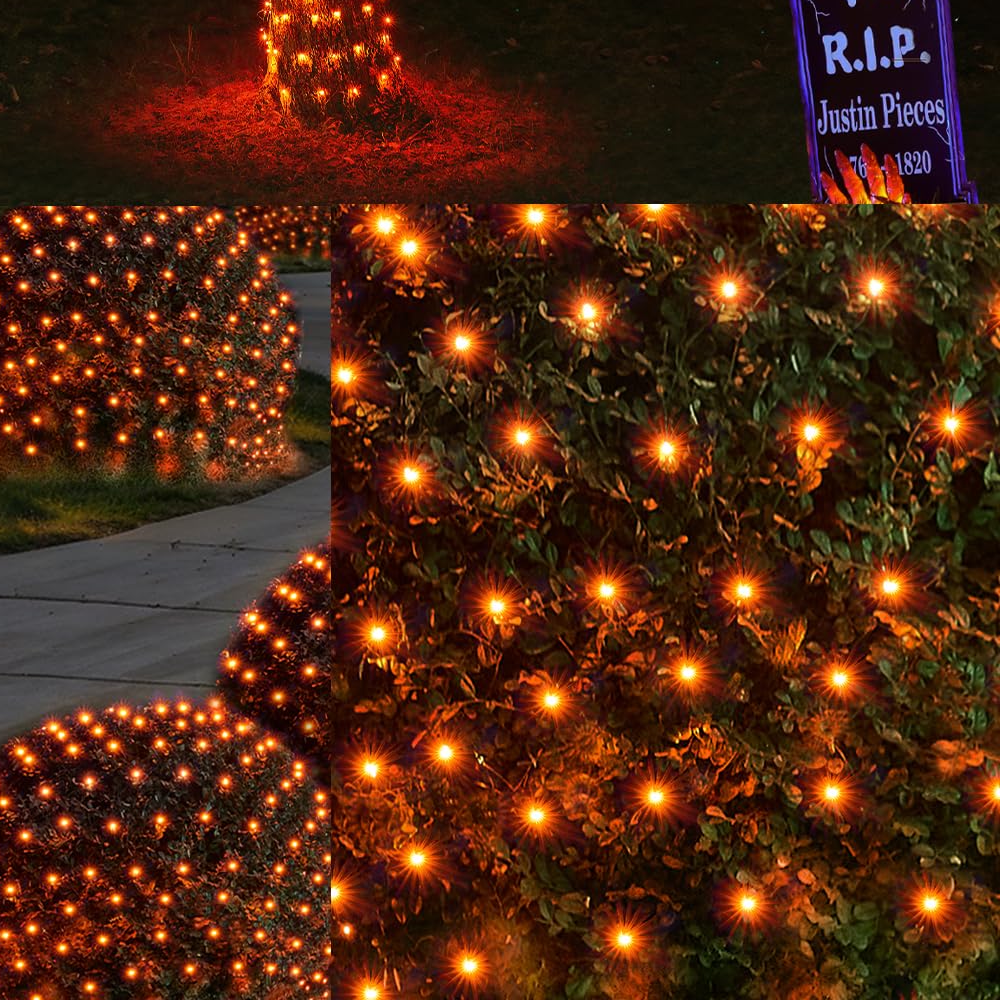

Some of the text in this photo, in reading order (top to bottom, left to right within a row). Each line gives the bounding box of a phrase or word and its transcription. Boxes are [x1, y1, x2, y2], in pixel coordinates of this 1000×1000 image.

[822, 25, 931, 75] R.I.P.
[817, 91, 945, 135] Justin Pieces
[895, 150, 932, 175] 1820
